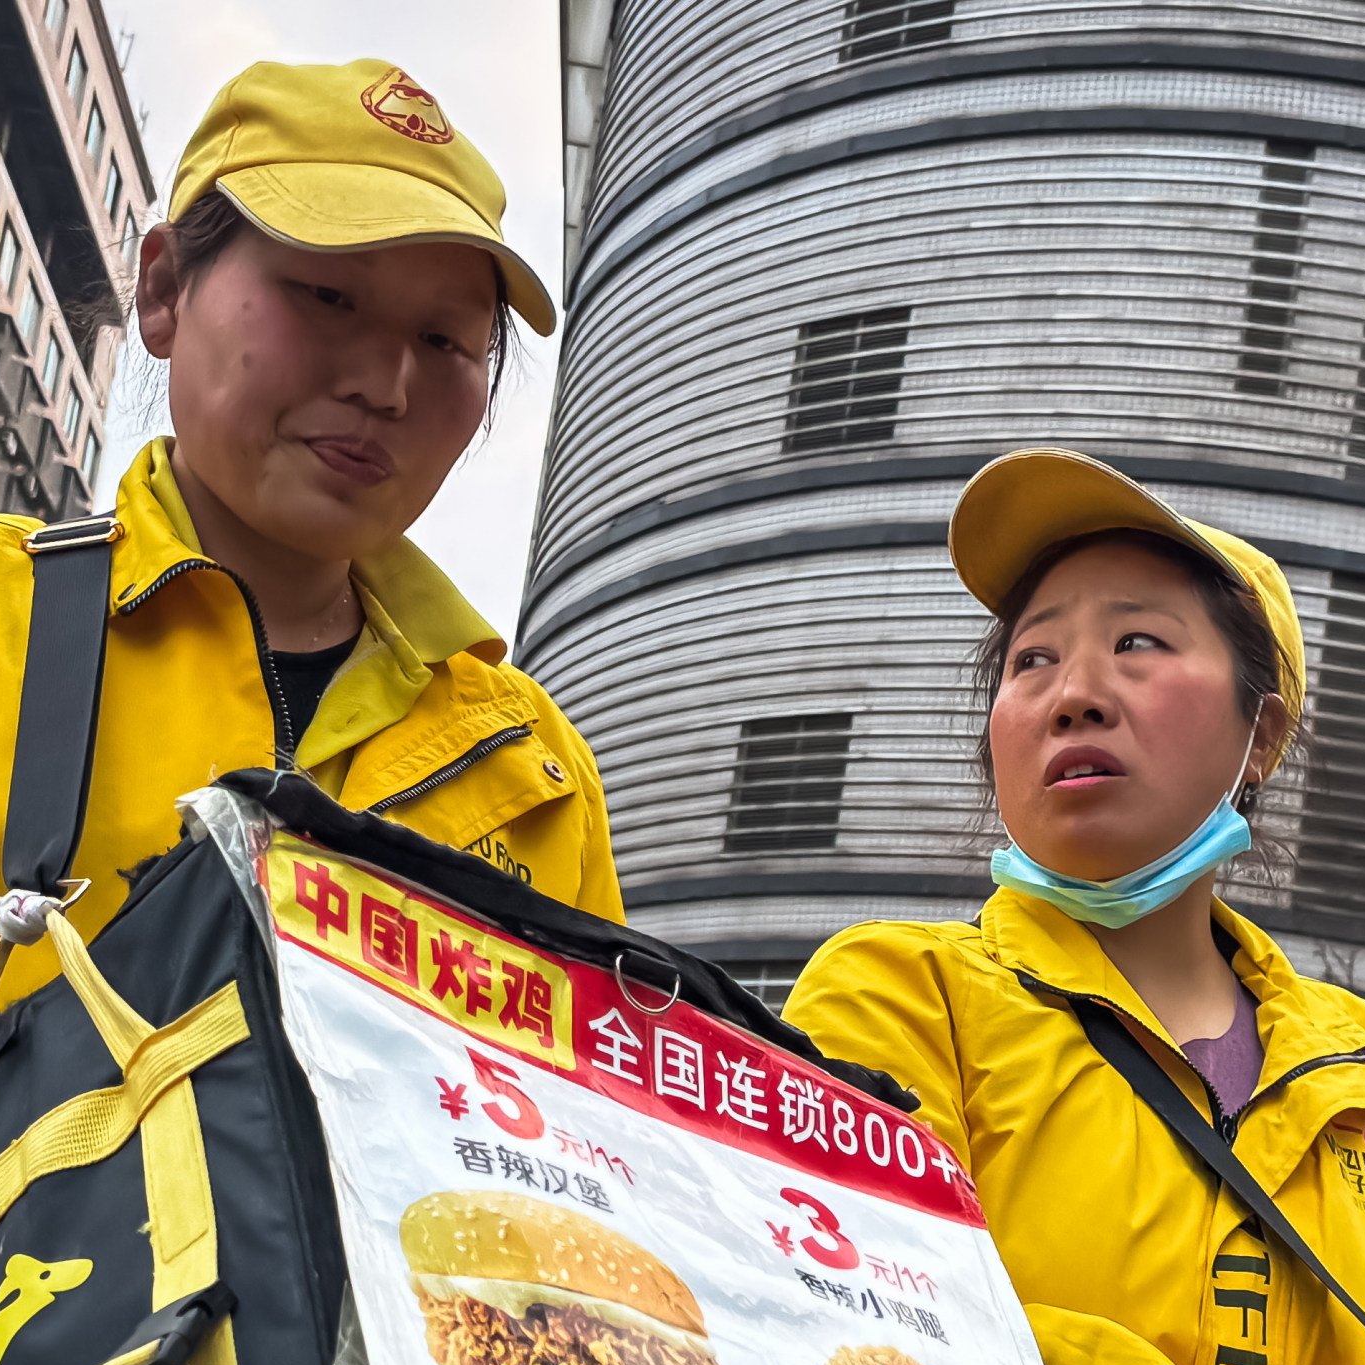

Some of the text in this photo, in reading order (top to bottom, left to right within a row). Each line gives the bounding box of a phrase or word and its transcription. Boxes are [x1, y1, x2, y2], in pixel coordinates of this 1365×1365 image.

[294, 861, 555, 1049] 中国炸鸡
[588, 1007, 958, 1184] 全国连锁800+
[453, 1136, 614, 1214] 香辣汉堡
[794, 1267, 951, 1346] 香辣小鸡腿
